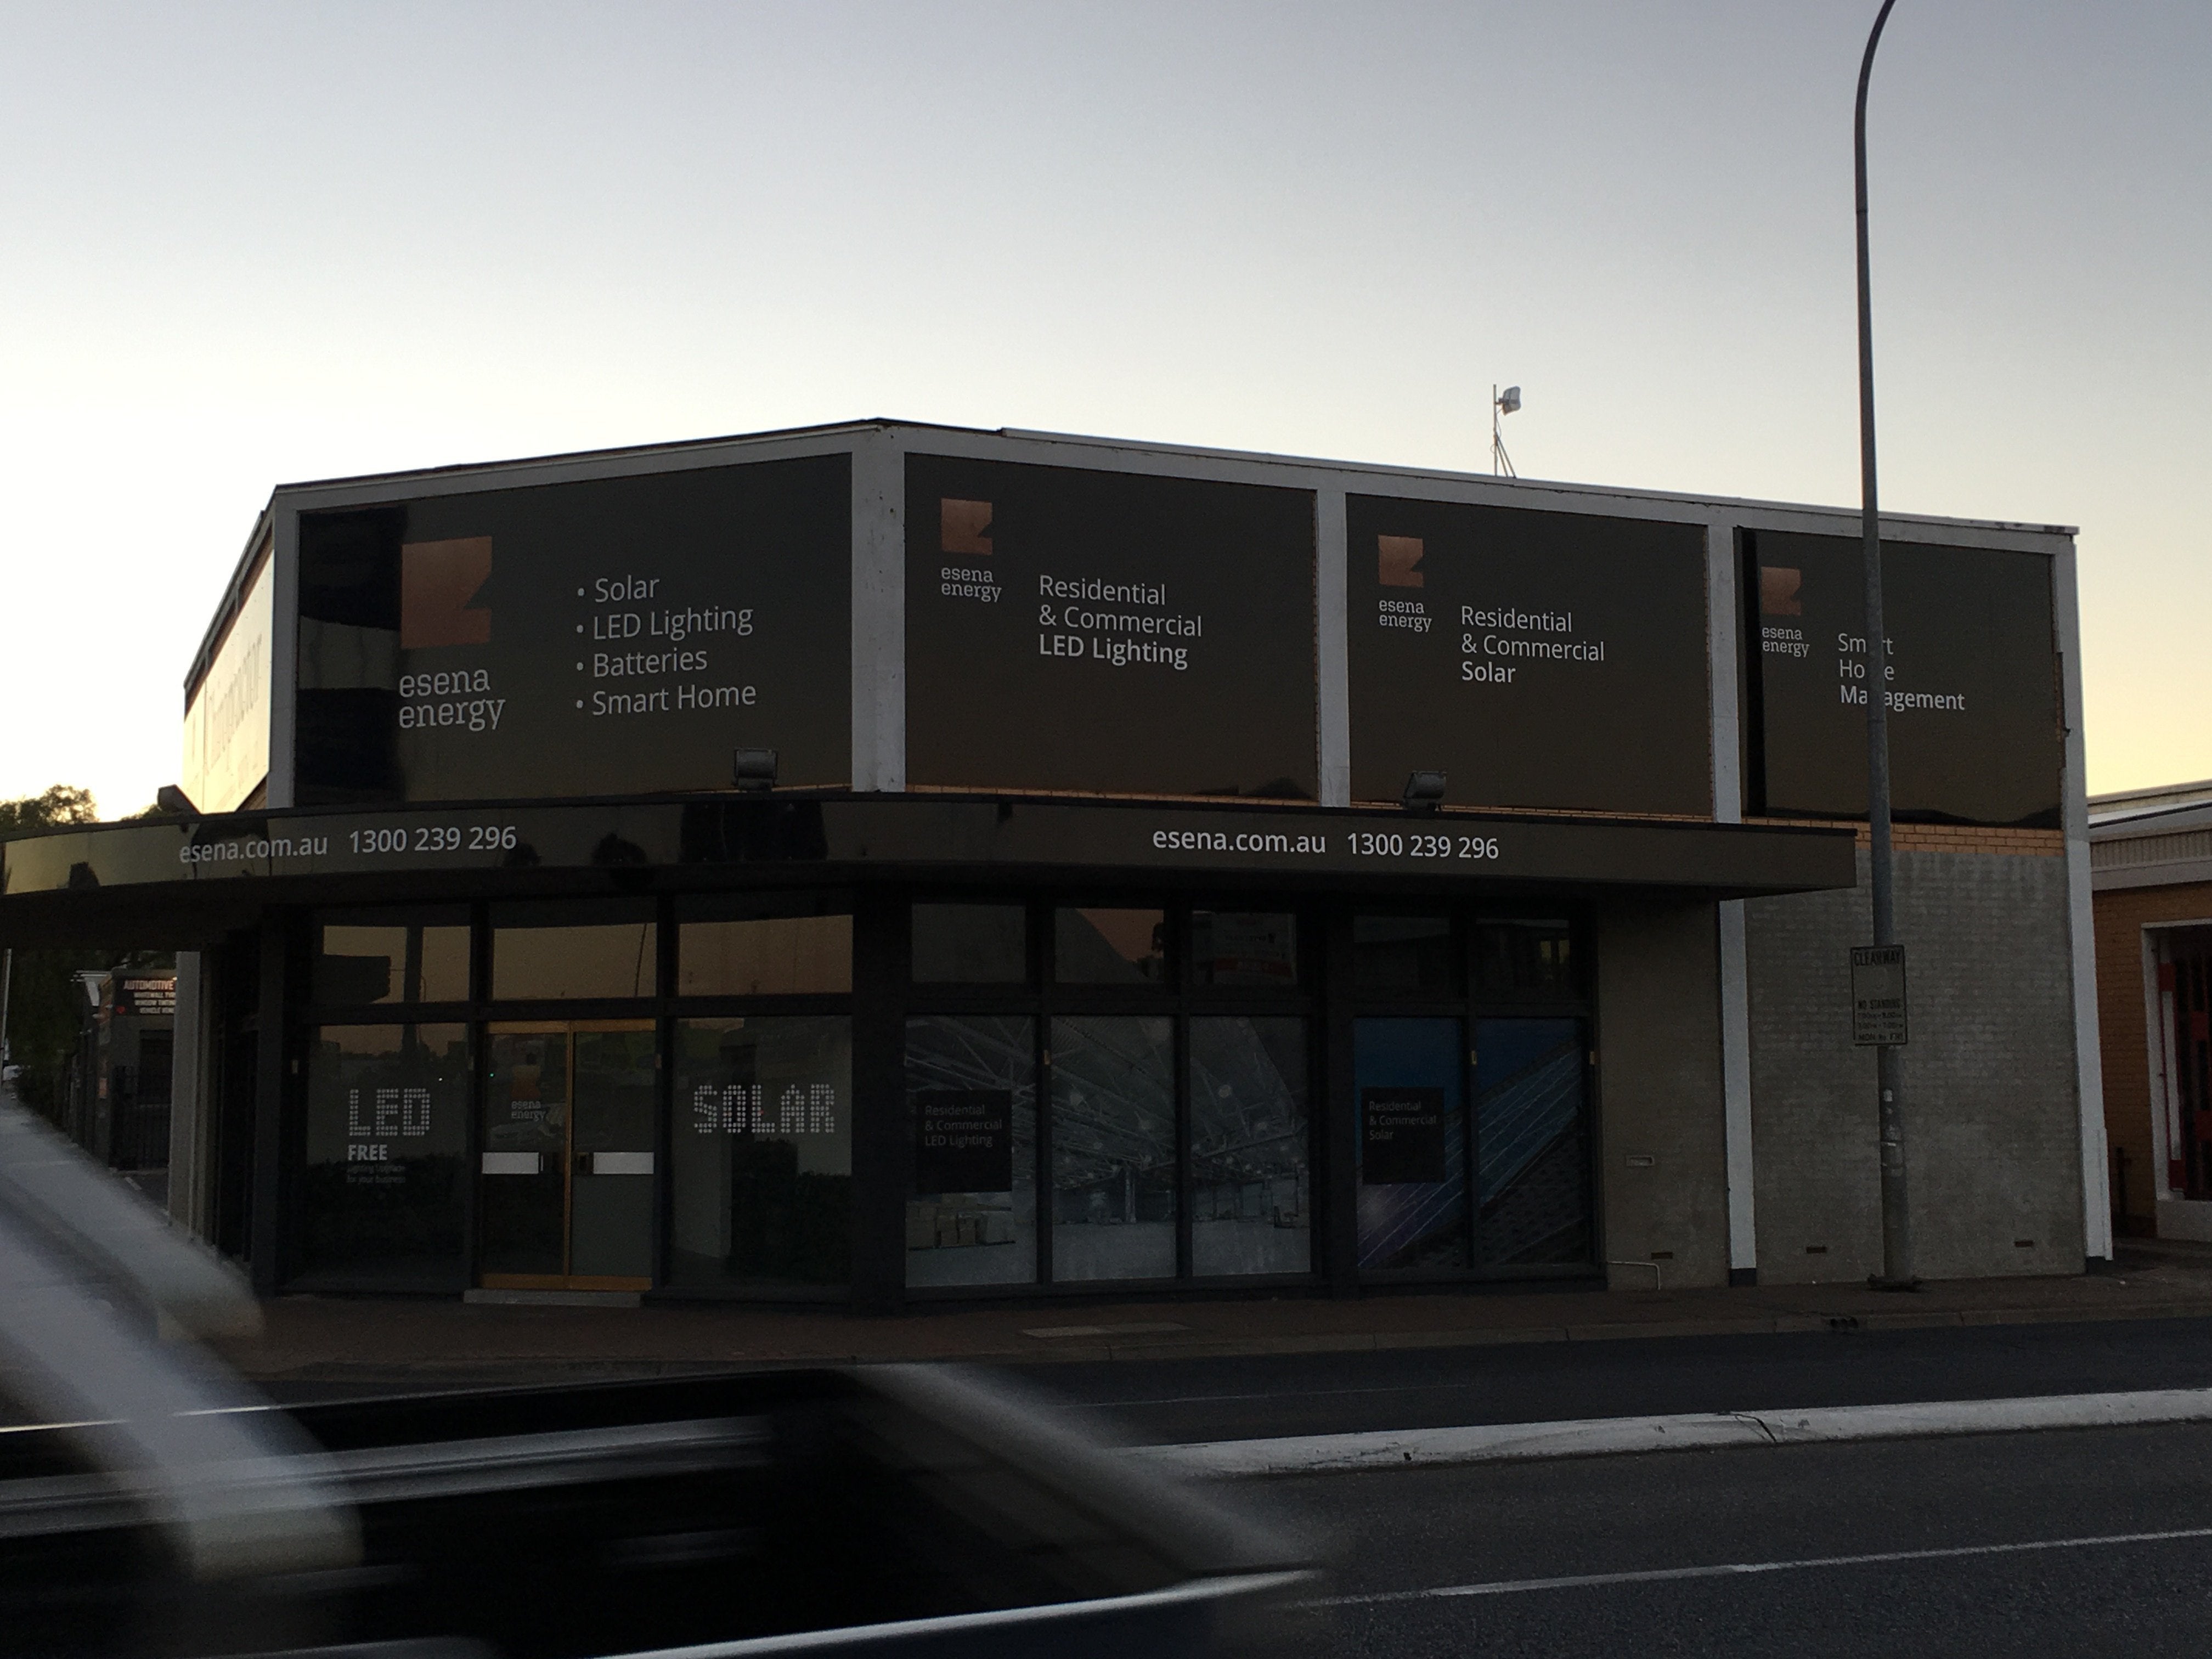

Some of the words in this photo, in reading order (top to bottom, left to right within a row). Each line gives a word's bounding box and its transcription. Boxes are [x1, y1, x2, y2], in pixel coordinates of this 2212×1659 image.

[941, 567, 993, 583] esena
[595, 575, 660, 603] Solar
[941, 582, 1002, 602] energy
[1040, 575, 1165, 605] Residential
[1379, 599, 1424, 614] esena
[593, 613, 641, 641] LED
[650, 606, 753, 641] Lighting
[1040, 605, 1056, 625] &
[1064, 606, 1201, 636] Commercial
[1379, 614, 1431, 633] energy
[1462, 606, 1572, 632] Residential
[1762, 627, 1802, 640] esena
[1040, 634, 1084, 657] LED
[1093, 638, 1187, 670] Lighting
[1462, 634, 1476, 653] &
[1484, 635, 1604, 661] Commercial
[1763, 640, 1809, 657] energy
[593, 648, 708, 678] Batteries
[1462, 662, 1515, 682] Solar
[1840, 660, 1894, 680] Hoe
[399, 667, 490, 697] esena
[592, 689, 668, 716] Smart
[677, 683, 757, 709] Home
[1841, 686, 1965, 712] Maagement
[398, 696, 506, 731] energy
[180, 835, 327, 863] esena.com.au
[349, 830, 407, 853] 1300
[414, 828, 461, 851] 239
[469, 826, 517, 851] 296
[1153, 830, 1325, 853] esena.com.au
[1347, 833, 1402, 856] 1300
[1410, 835, 1451, 857] 239
[1459, 837, 1499, 859] 296
[1854, 950, 1900, 966] CLEARWAY
[123, 980, 173, 990] AUTOMOTIVE
[349, 1088, 430, 1136] LED
[511, 1101, 541, 1109] esena
[694, 1084, 836, 1133] SOLAR
[925, 1105, 985, 1115] Residential
[1369, 1101, 1421, 1111] Residential
[511, 1111, 546, 1122] energy
[925, 1121, 933, 1131] &
[936, 1120, 1002, 1131] Commercial
[1369, 1116, 1376, 1126] &
[1379, 1115, 1436, 1125] Commercial
[925, 1136, 945, 1146] LED
[950, 1136, 992, 1148] Lighting
[1369, 1130, 1393, 1141] Solar
[348, 1144, 387, 1160] FREE
